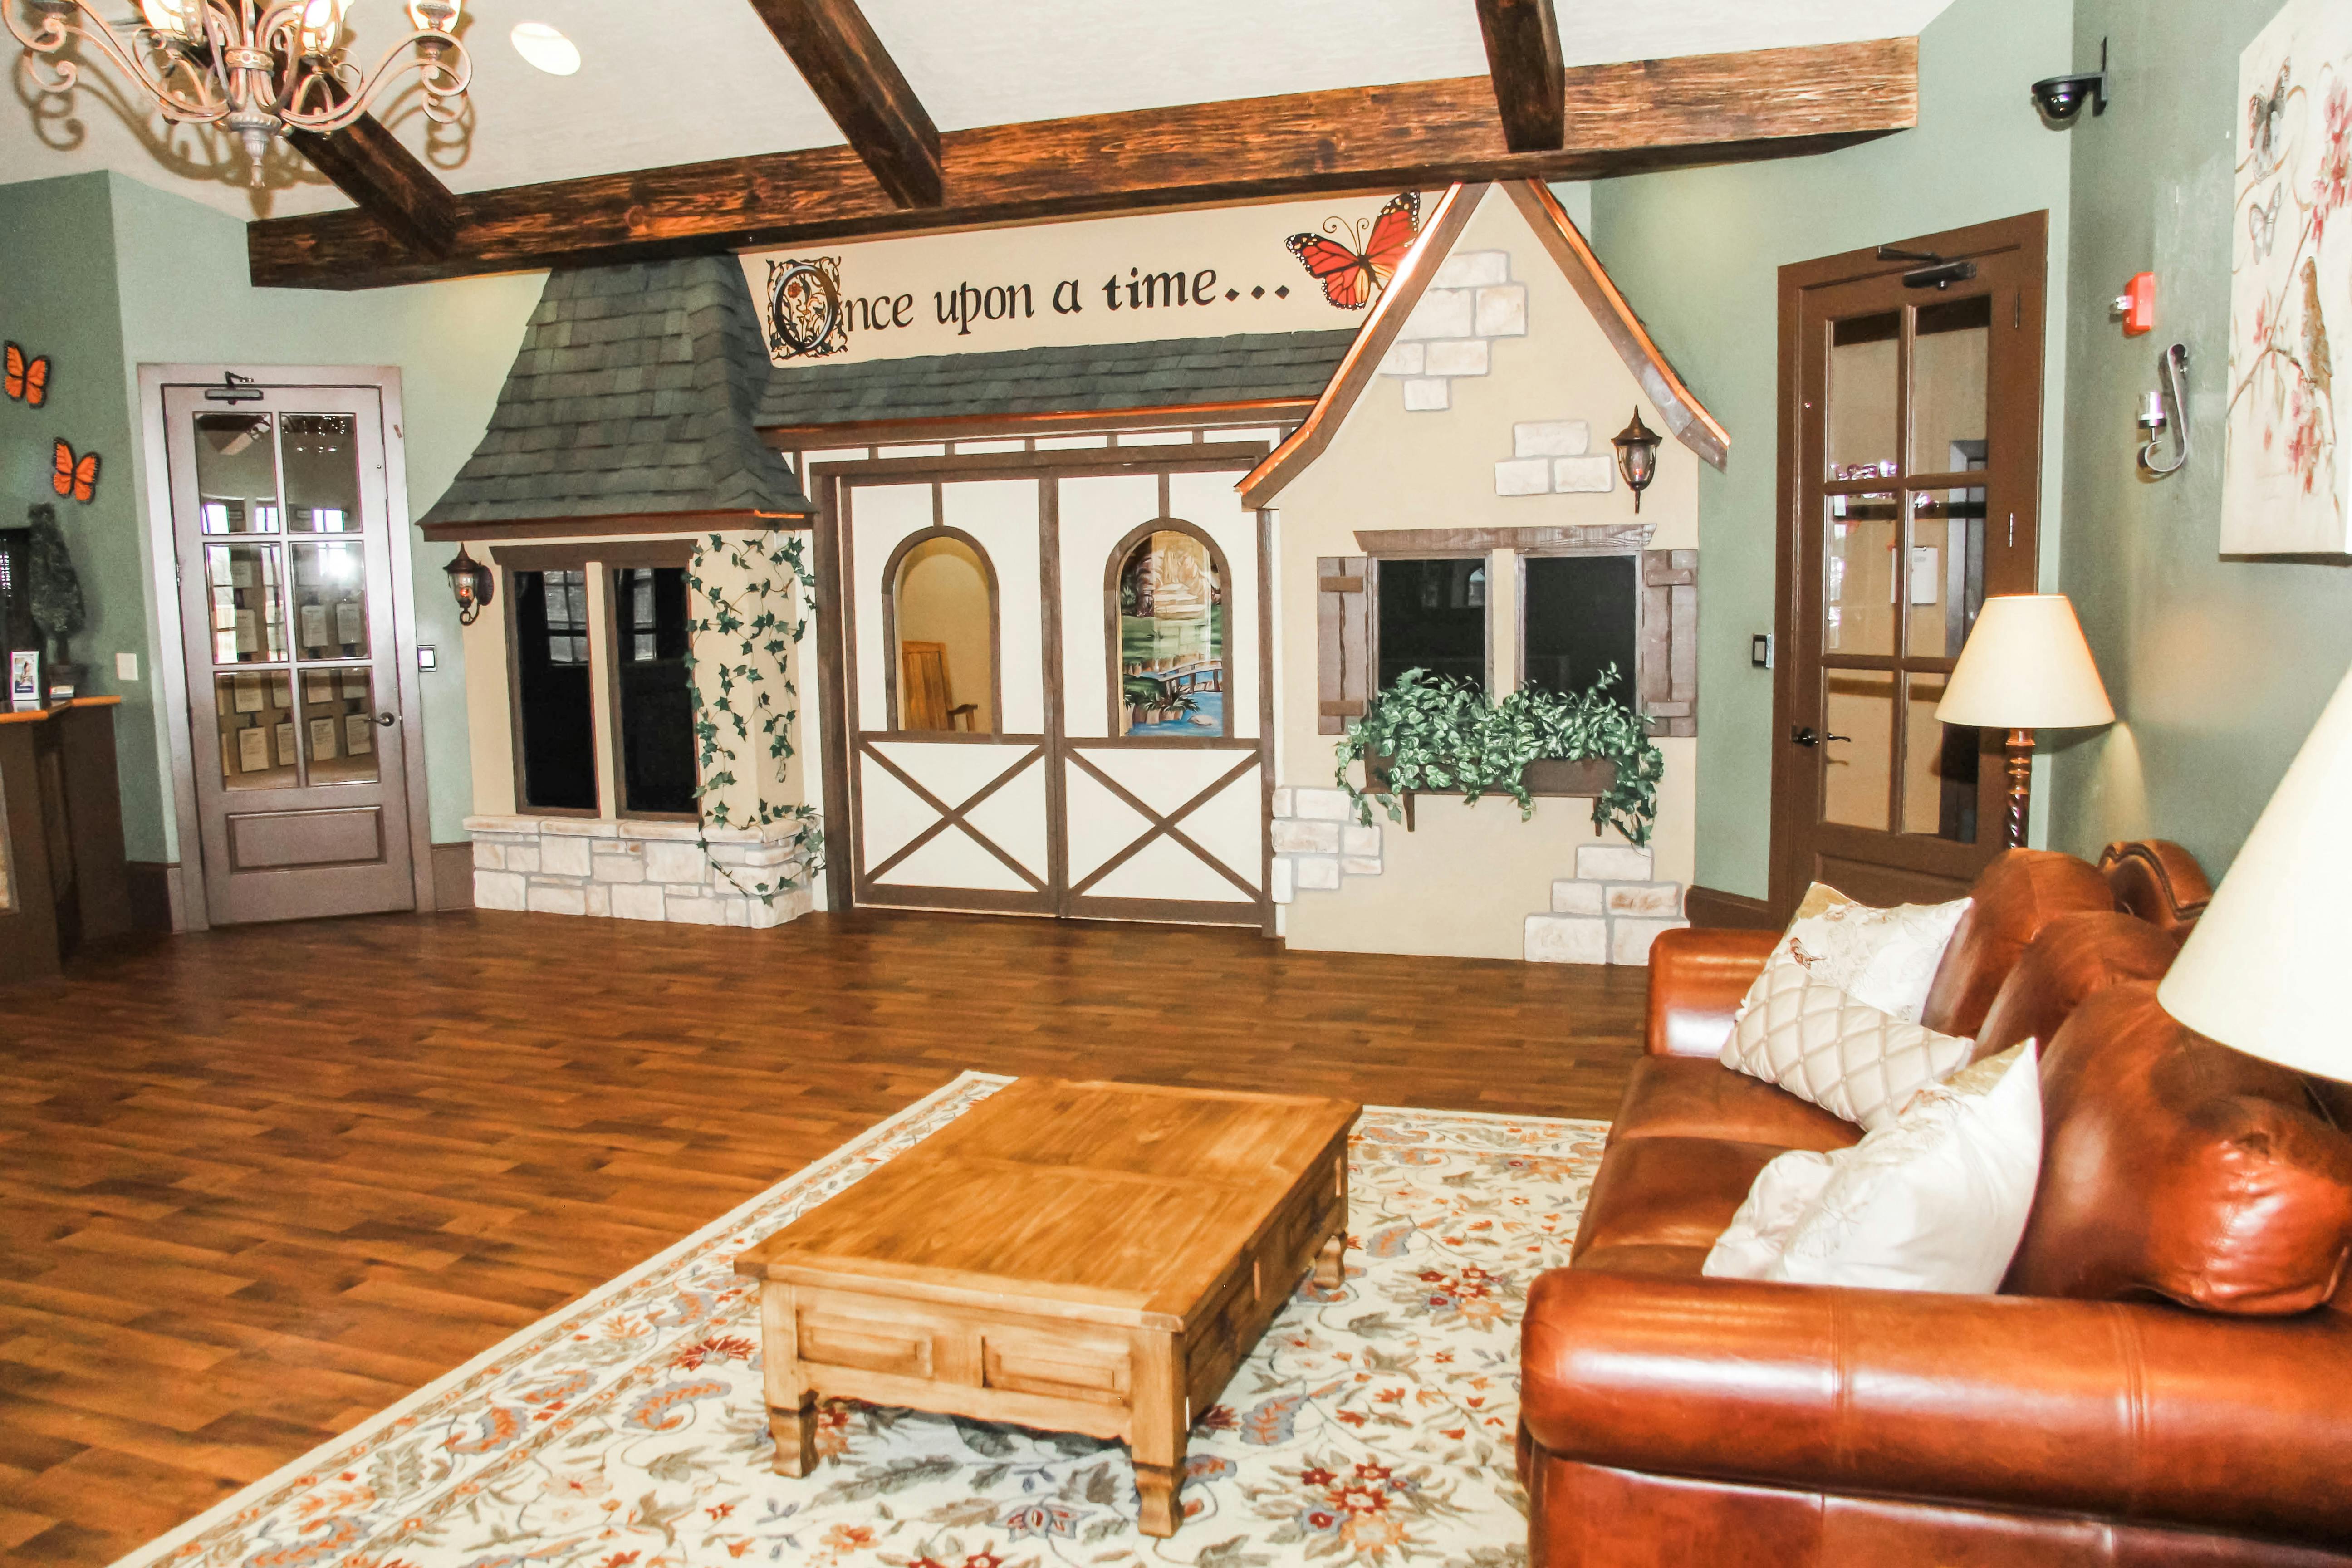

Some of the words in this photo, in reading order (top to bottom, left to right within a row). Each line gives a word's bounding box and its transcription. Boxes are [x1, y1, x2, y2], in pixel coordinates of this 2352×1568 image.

[768, 257, 913, 356] Once
[934, 281, 1034, 335] upon
[1053, 279, 1083, 314] a
[1102, 267, 1290, 311] time...
